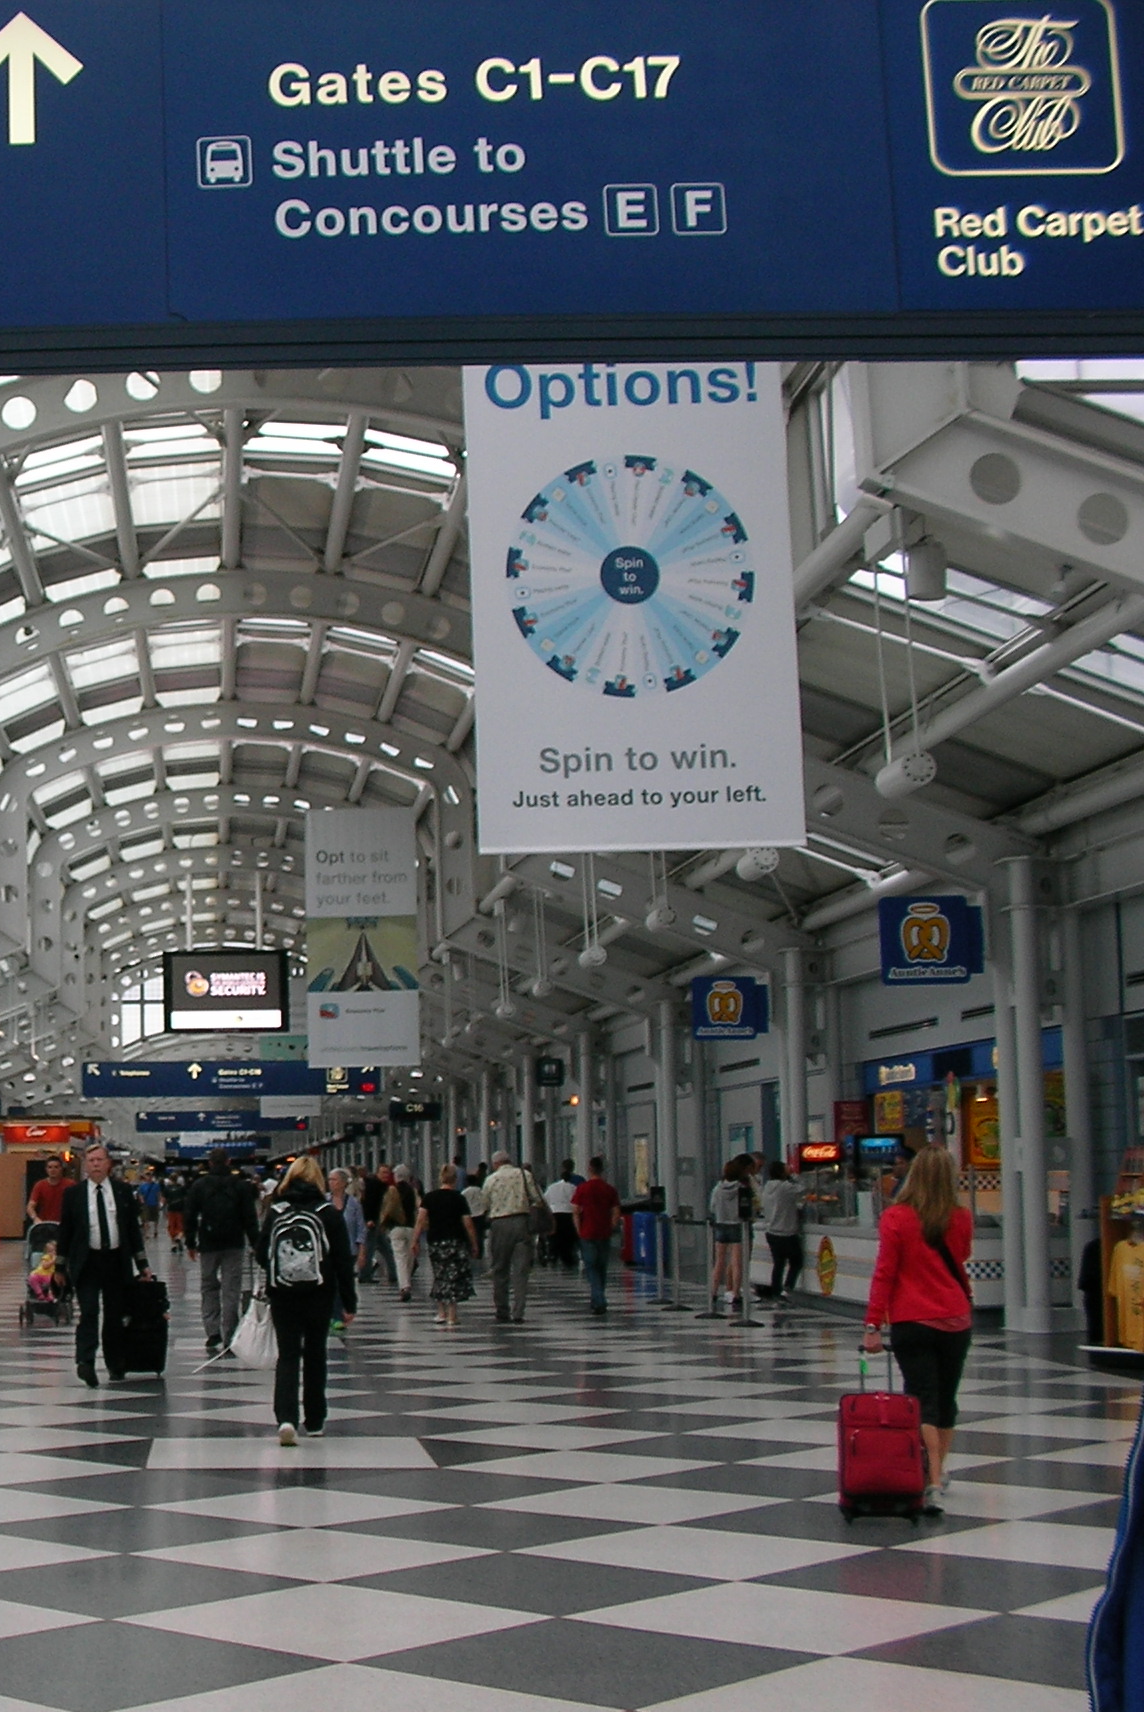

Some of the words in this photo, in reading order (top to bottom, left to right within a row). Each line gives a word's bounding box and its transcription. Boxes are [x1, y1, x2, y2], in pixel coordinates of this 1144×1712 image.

[268, 62, 448, 107] Gates
[475, 55, 681, 101] C1-C17
[971, 75, 1006, 91] RED
[1008, 74, 1073, 90] CARPET
[271, 136, 457, 179] Shuttle
[473, 136, 526, 173] to
[274, 198, 589, 239] Concourses
[616, 191, 648, 229] E
[684, 190, 714, 228] F
[934, 206, 1006, 239] Red
[1016, 204, 1143, 243] Carpet
[937, 245, 1025, 277] Club
[484, 362, 758, 420] Options!
[614, 557, 644, 569] Spin
[623, 572, 637, 582] to
[539, 747, 613, 779] Spin
[625, 747, 659, 771] to
[671, 744, 736, 769] win.
[513, 790, 559, 808] Just
[567, 789, 633, 807] ahead
[642, 788, 663, 805] to
[670, 789, 719, 808] your
[726, 785, 767, 803] left.
[316, 850, 344, 865] Opt
[350, 851, 366, 862] to
[371, 850, 388, 862] sit
[373, 870, 407, 884] from
[316, 893, 350, 908] your
[890, 967, 928, 978] Auntie
